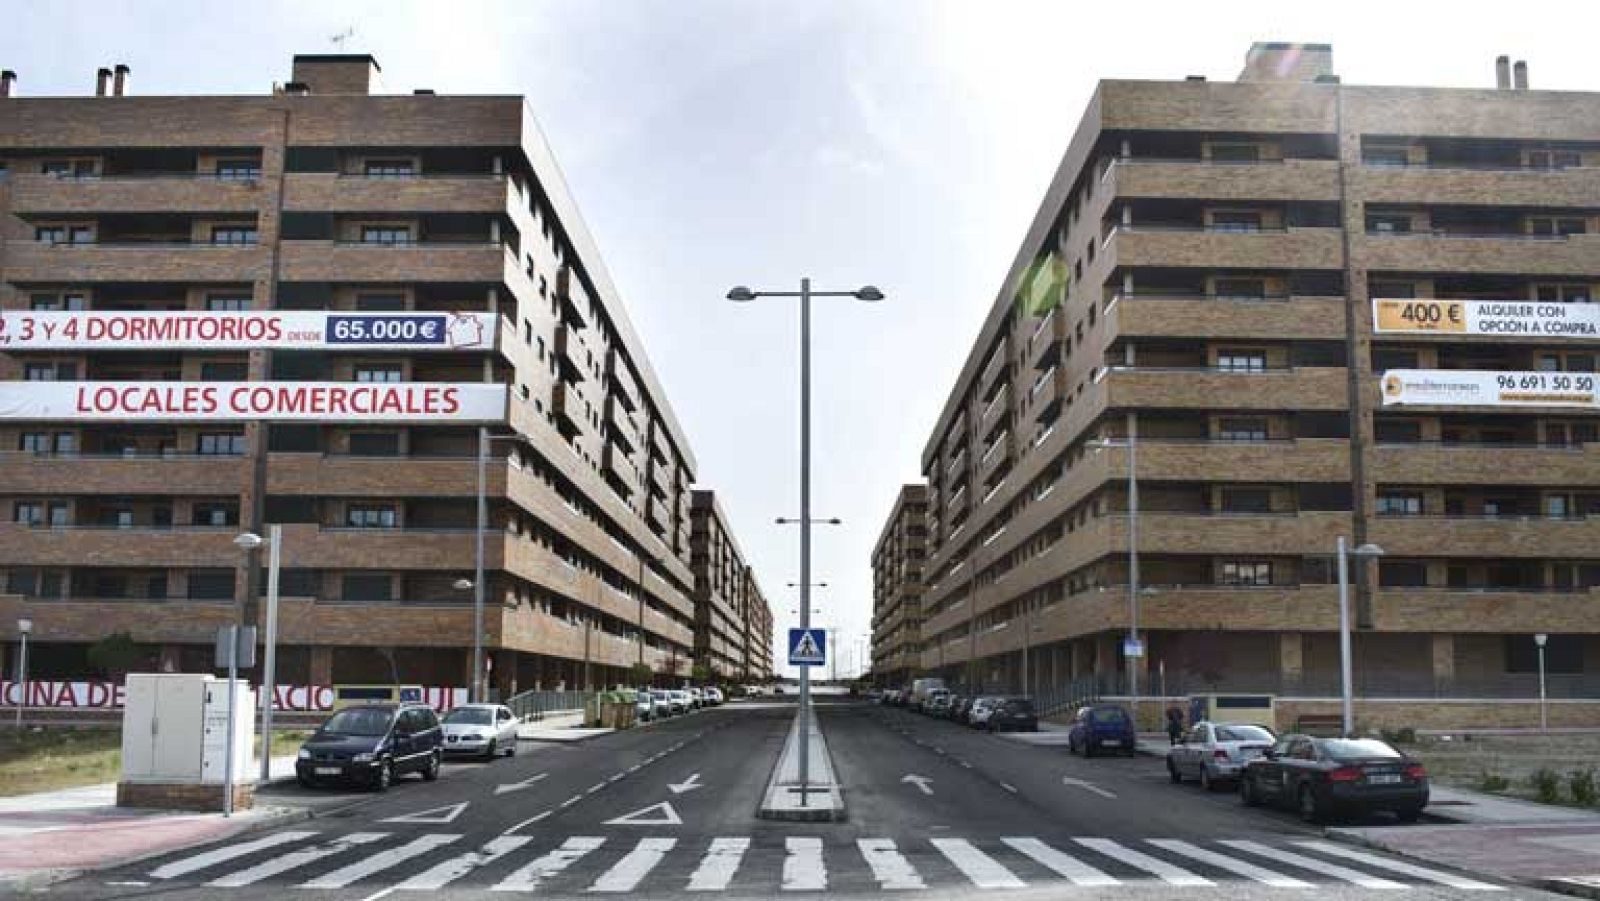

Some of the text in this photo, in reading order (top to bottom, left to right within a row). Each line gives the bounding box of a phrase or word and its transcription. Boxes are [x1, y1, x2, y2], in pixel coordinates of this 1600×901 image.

[1401, 303, 1461, 323] 400 €
[1478, 304, 1566, 318] ALQUILER CON
[19, 317, 35, 341] 3
[42, 322, 57, 341] Y
[63, 317, 79, 341] 4
[86, 316, 282, 341] DORMITORIOS
[1531, 321, 1541, 332] A
[1544, 321, 1597, 334] COMPRA
[1497, 374, 1593, 391] 96 691 50 50
[76, 386, 460, 413] LOCALES COMERCIALES
